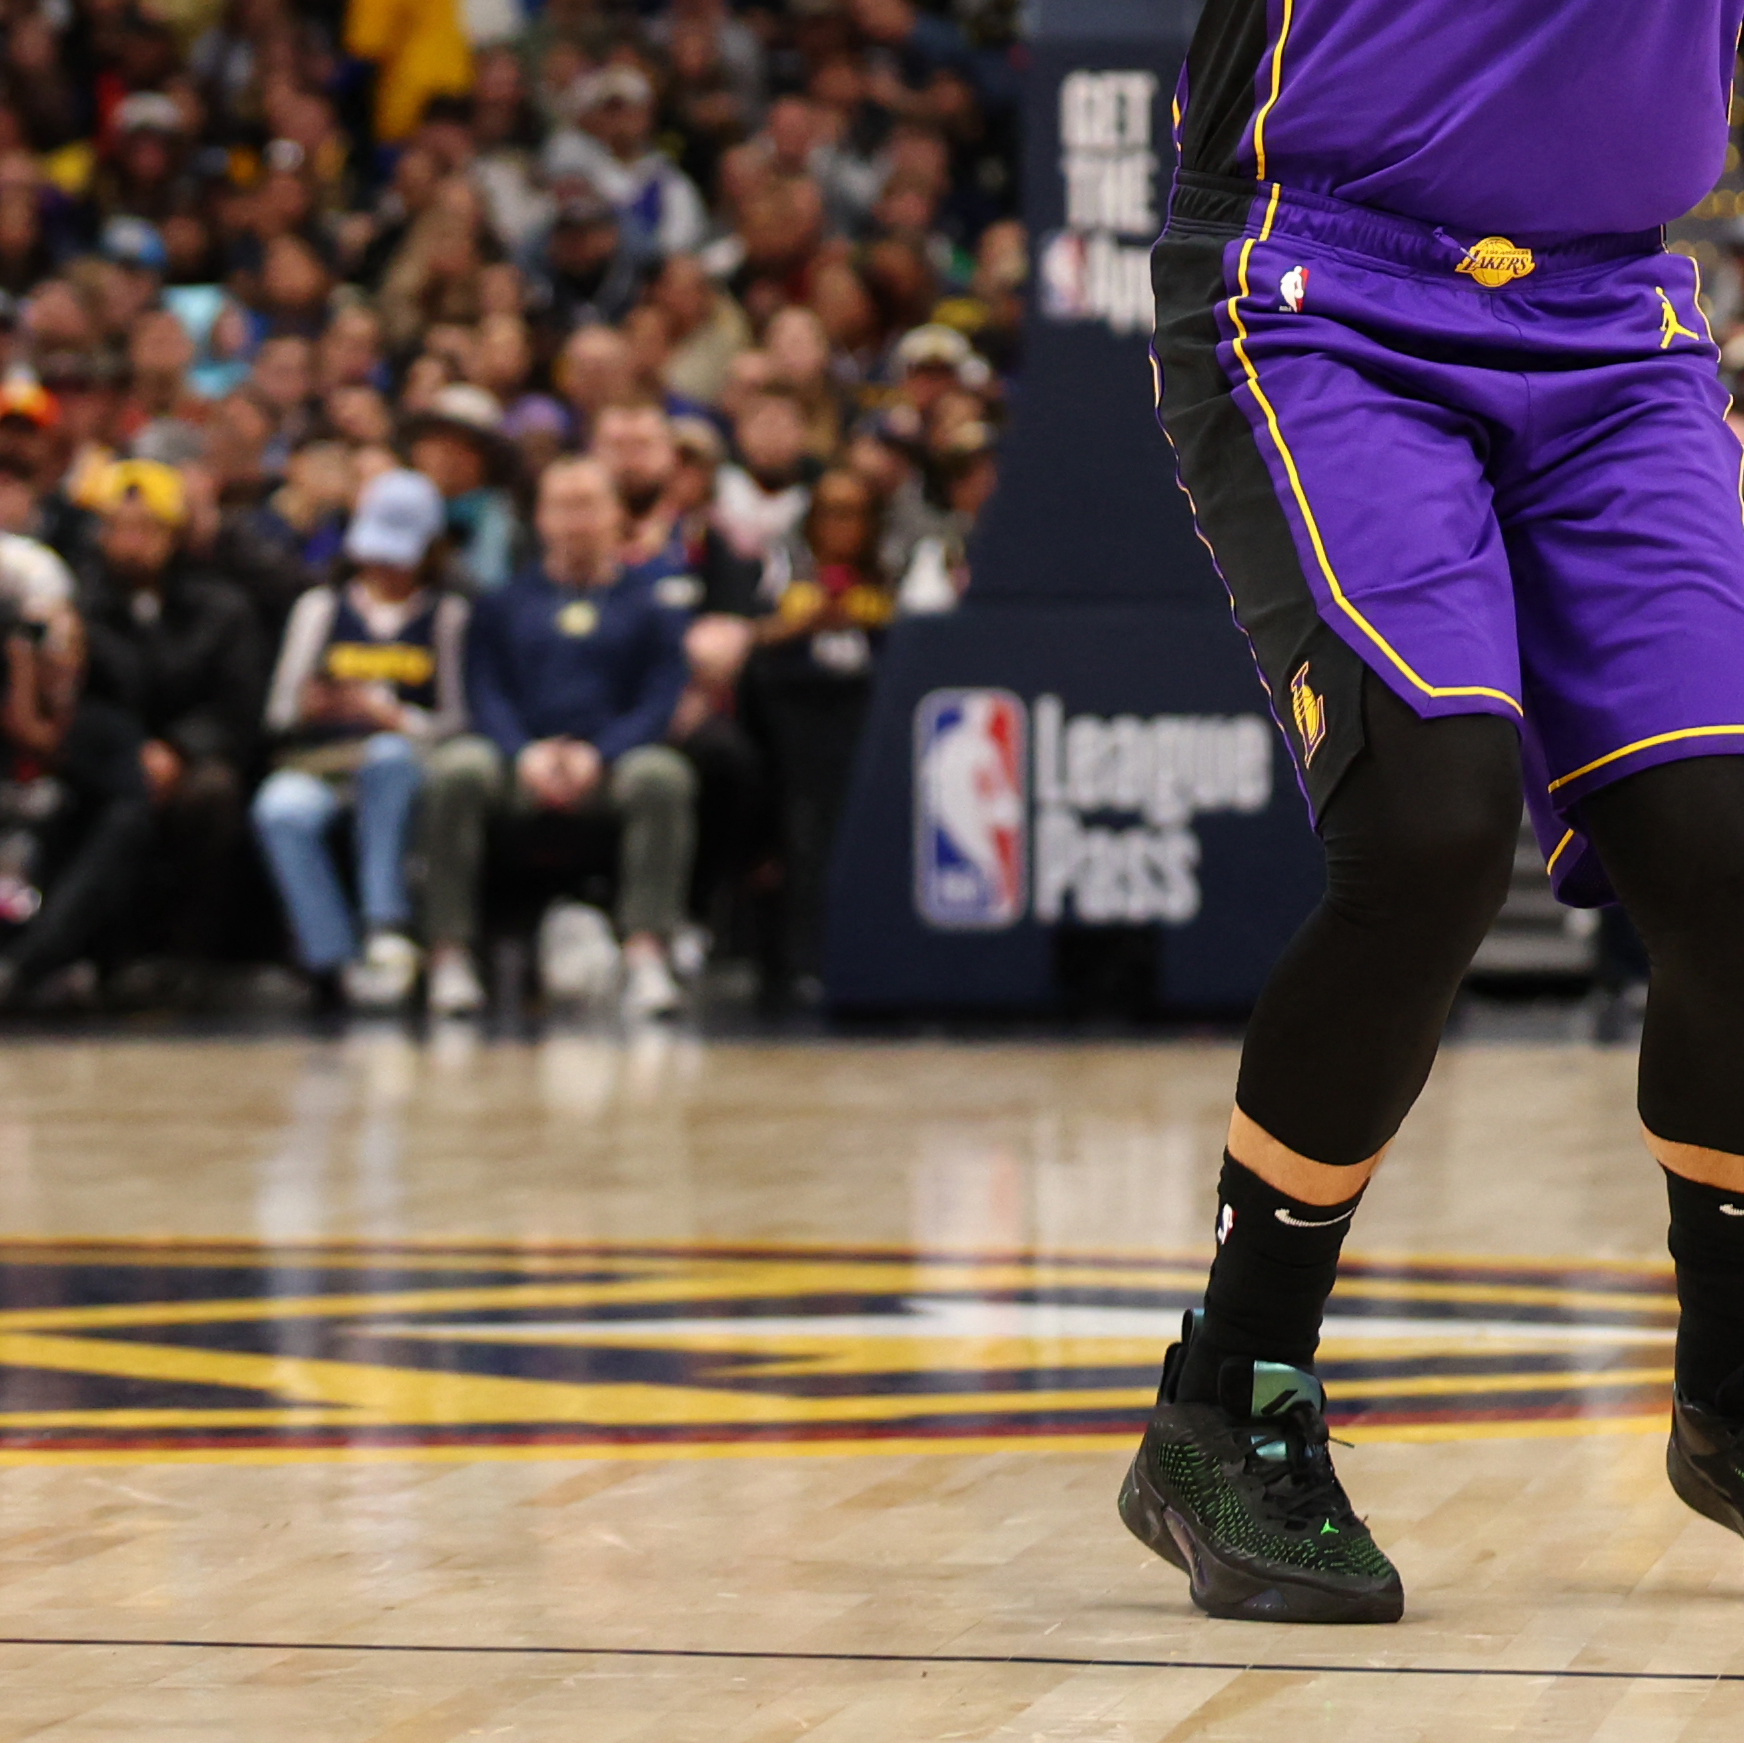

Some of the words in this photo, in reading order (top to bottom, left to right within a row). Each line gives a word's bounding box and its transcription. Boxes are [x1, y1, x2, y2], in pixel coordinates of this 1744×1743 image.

[1060, 68, 1157, 149] GET
[1460, 248, 1532, 276] LAKERS
[1034, 693, 1274, 828] League
[1034, 808, 1203, 926] Pass
